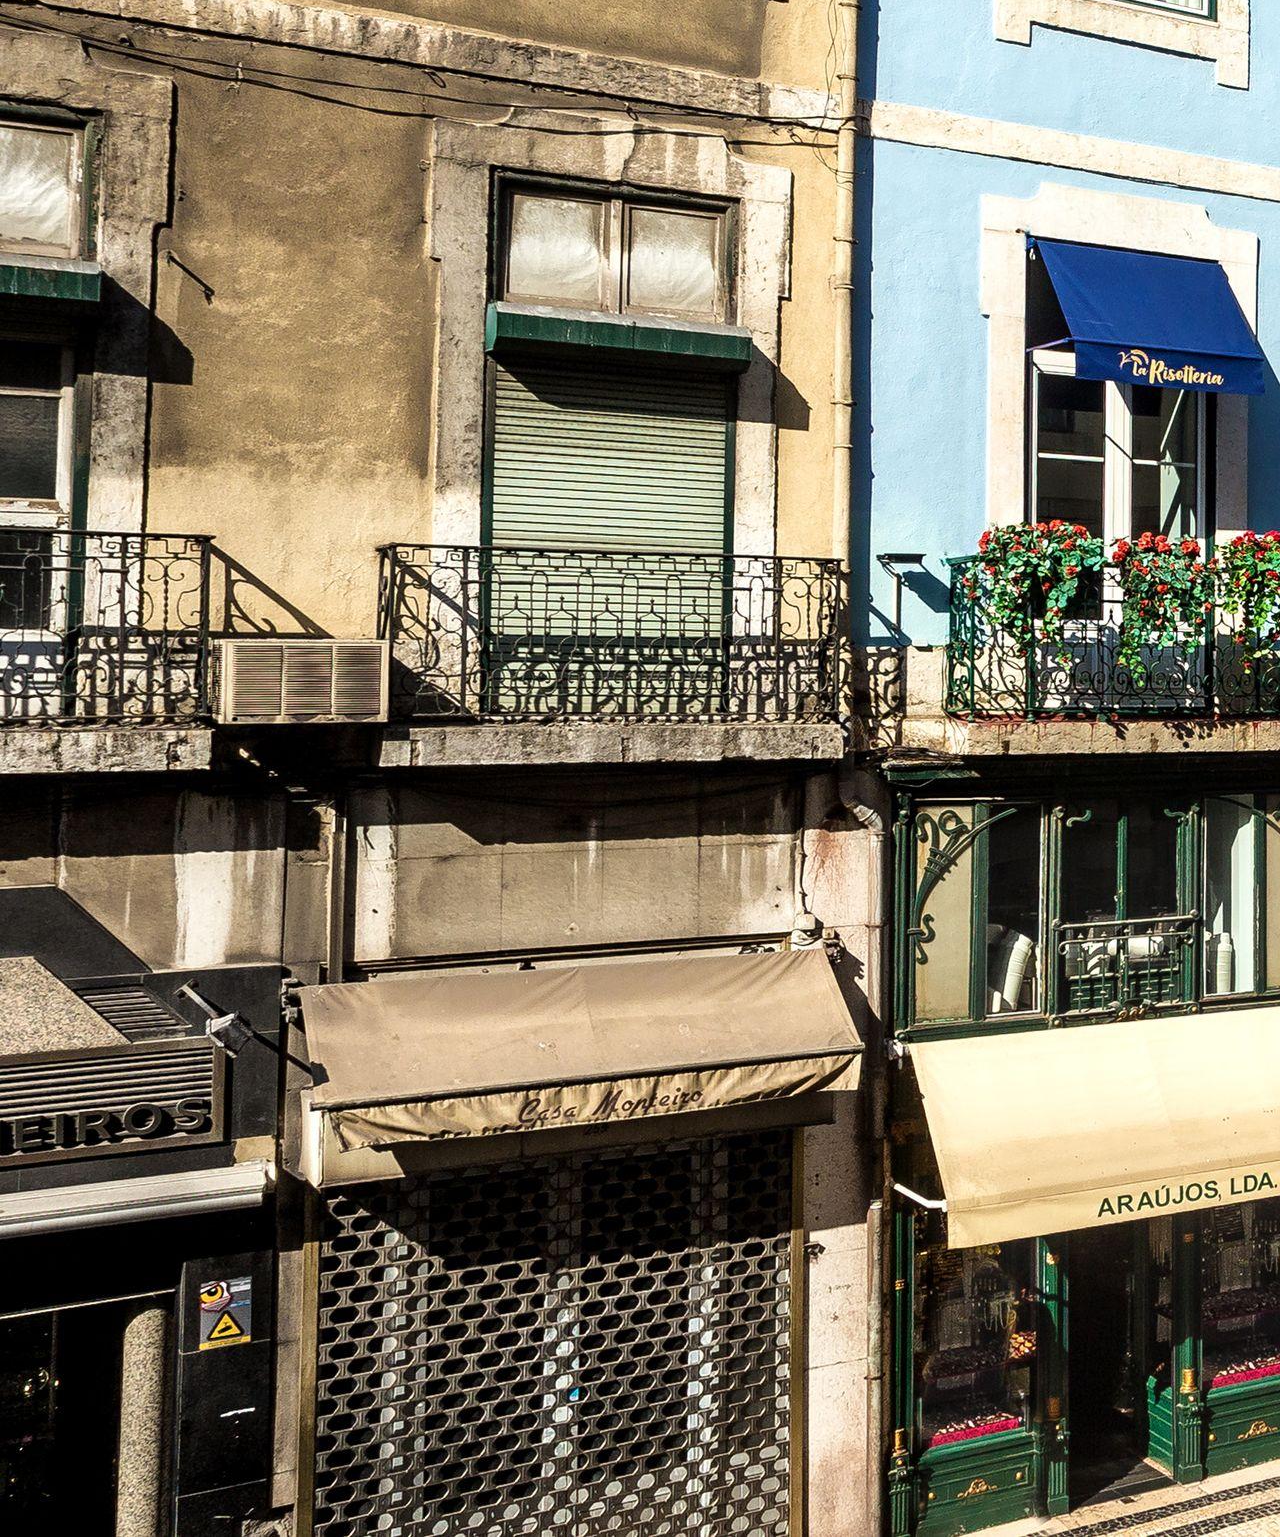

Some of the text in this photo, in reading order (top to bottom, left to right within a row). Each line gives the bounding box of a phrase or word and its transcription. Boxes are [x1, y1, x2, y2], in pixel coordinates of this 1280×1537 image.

[1148, 358, 1225, 386] Risotteria
[13, 1097, 210, 1150] EIROS
[518, 1087, 704, 1124] Casa Monteiro
[1097, 1172, 1278, 1218] ARAÚJOS, LDA.
